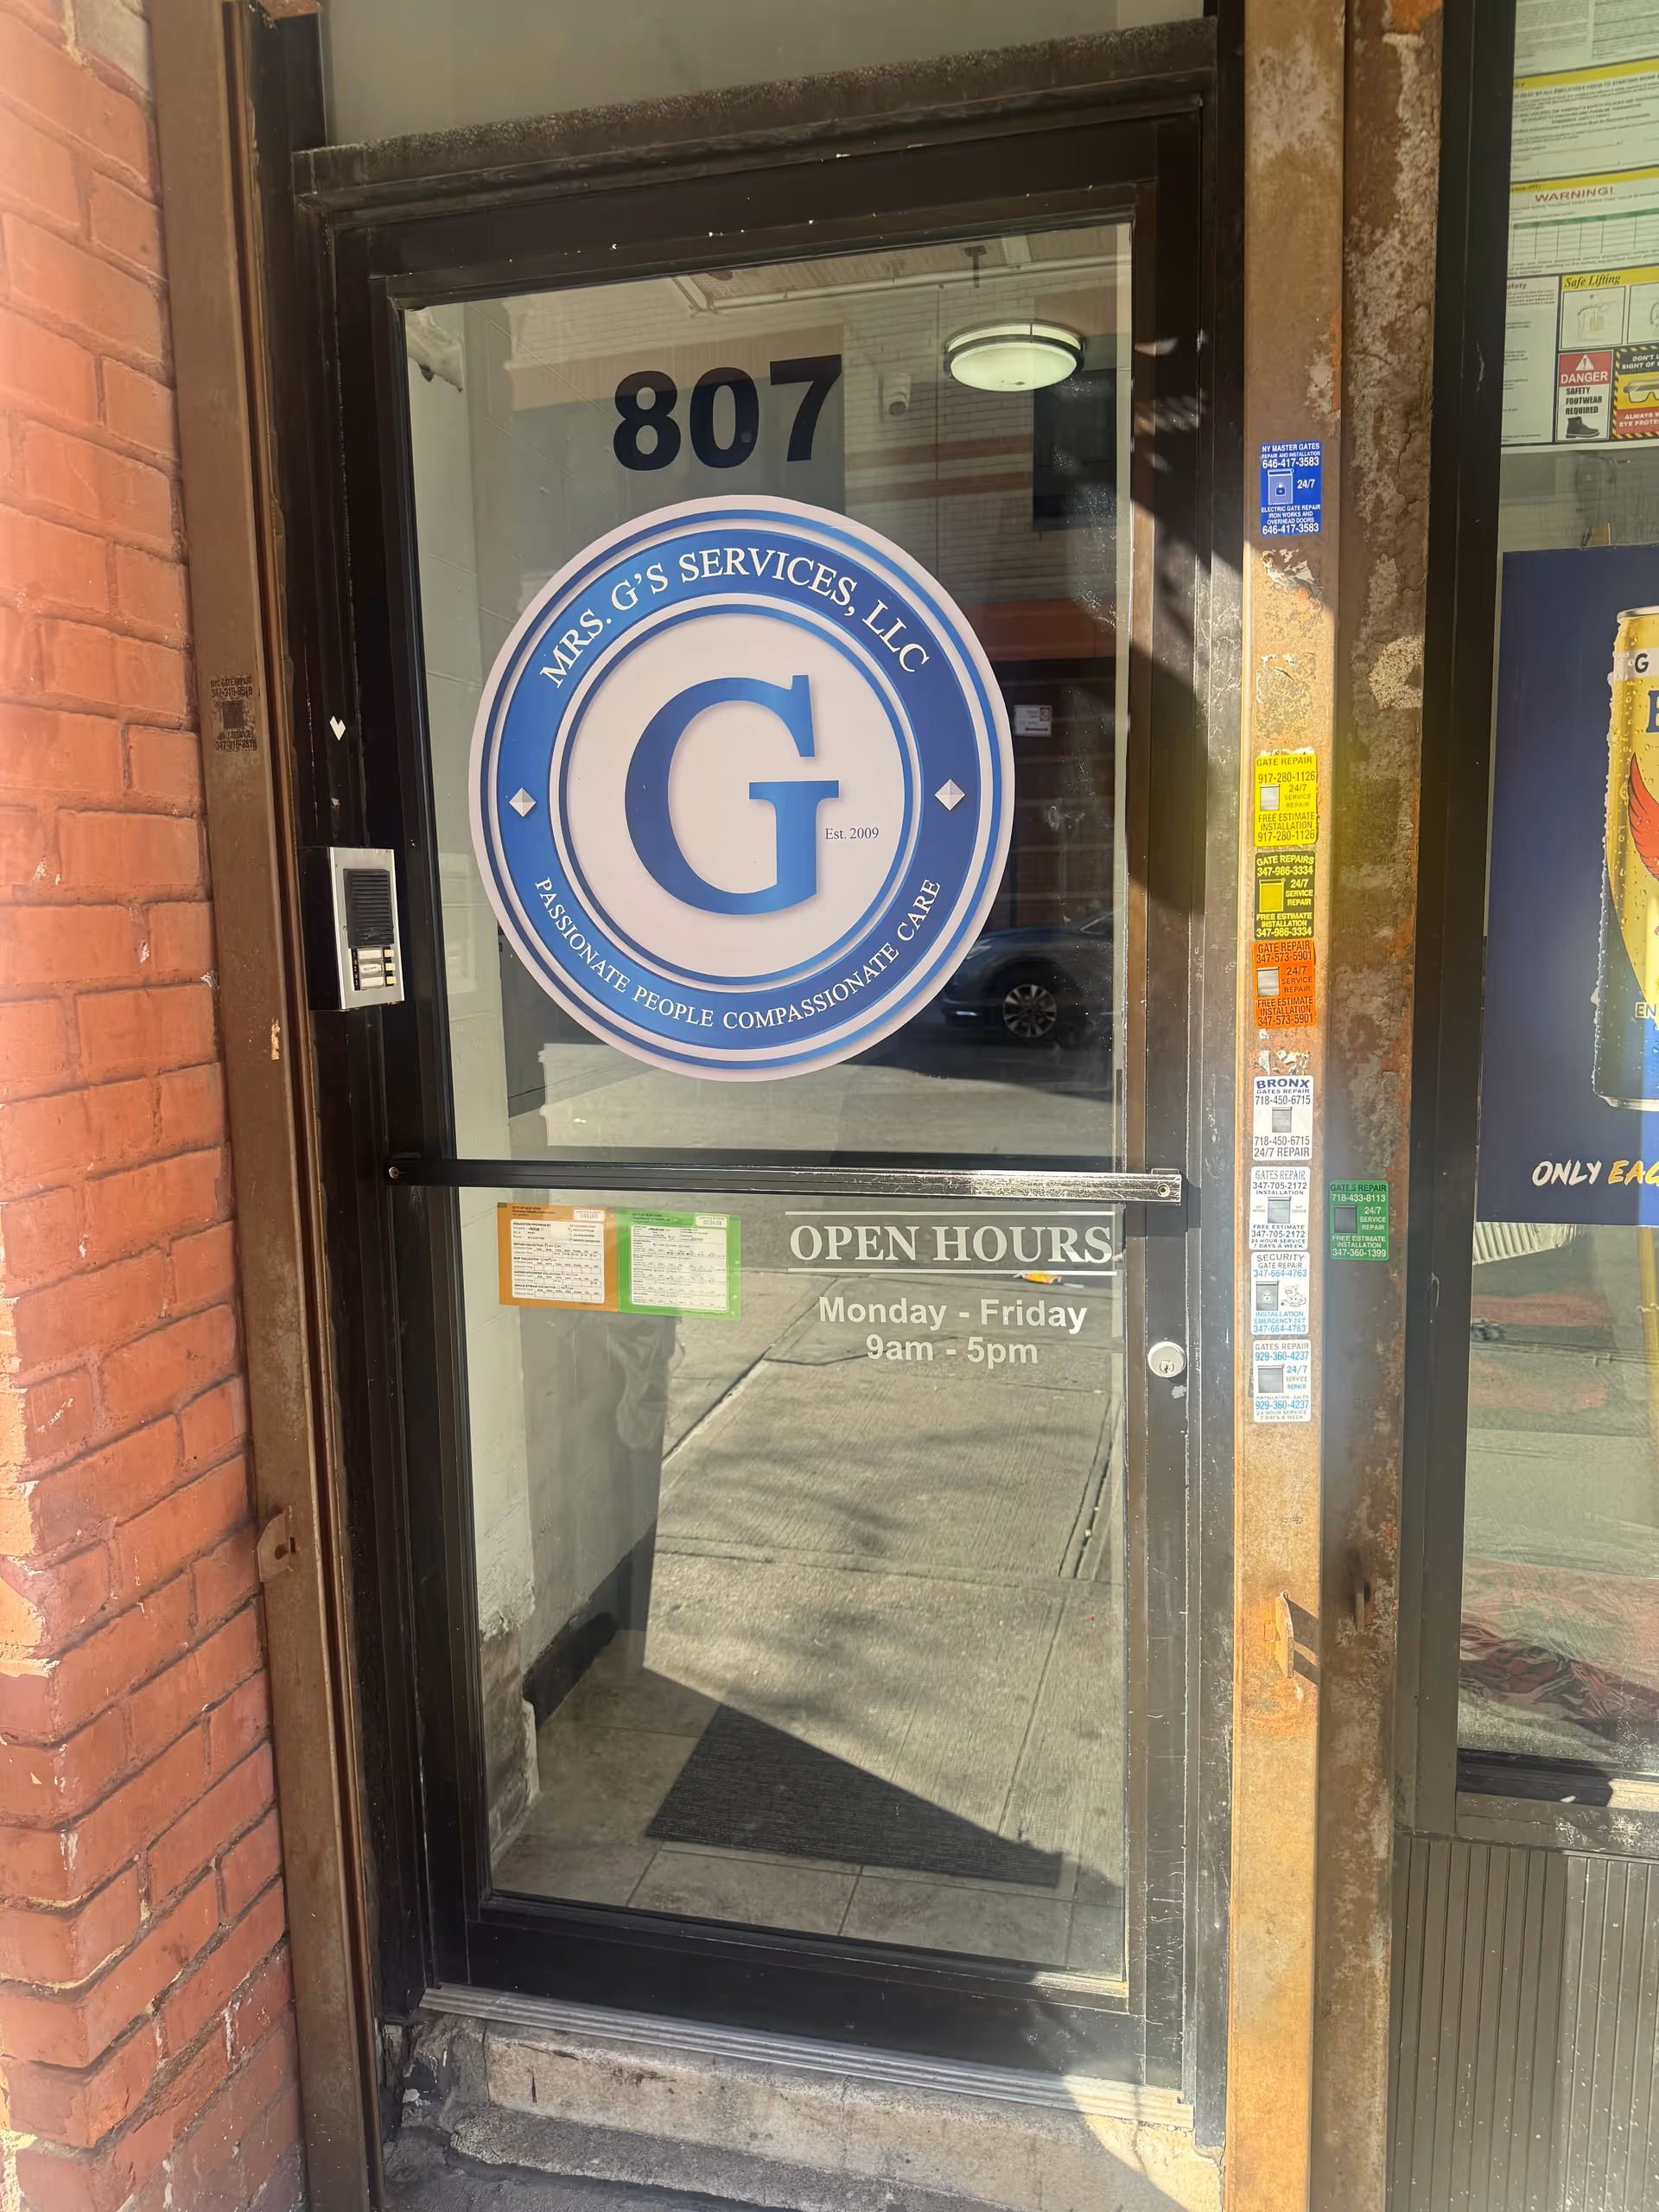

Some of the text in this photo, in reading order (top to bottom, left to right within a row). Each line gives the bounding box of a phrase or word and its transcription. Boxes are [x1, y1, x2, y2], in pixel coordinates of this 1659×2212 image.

[1535, 186, 1613, 202] WARNING!
[1565, 275, 1620, 289] Safe Lifting
[1561, 372, 1607, 384] DANGER
[1566, 396, 1602, 405] FOOTWEAR
[613, 354, 842, 471] 807
[1566, 406, 1598, 415] REQUIRED
[1262, 457, 1319, 469] 646-417-3583
[1297, 479, 1315, 489] 24/7
[1262, 523, 1319, 535] 646-417-3583
[539, 547, 931, 689] MRS. G'S SERVICES, LLC
[1635, 653, 1649, 673] G
[1257, 757, 1312, 766] GATE REPAIR
[1258, 771, 1315, 784] 917-280-1126
[625, 675, 840, 915] G
[1258, 812, 1314, 822] FREE ESTIMATE
[1261, 821, 1312, 831] INSTALLATION
[824, 826, 880, 841] Est. 2009
[1258, 830, 1315, 842] 917-280-1126
[1257, 855, 1314, 866] GATE REPAIRS
[1257, 866, 1313, 876] 347-986-3334
[1291, 879, 1309, 888] 24/7
[1256, 927, 1312, 937] 347-986-3334
[1258, 941, 1310, 953] GATE REPAIR
[535, 877, 941, 1030] PASSIONATE PEOPLE COMPASSIONATE CARE
[1257, 951, 1312, 964] 347-573-5901
[1287, 966, 1307, 975] 24/7
[1258, 996, 1313, 1008] FREE ESTIMATE
[1260, 1005, 1310, 1016] INSTALLATION
[1258, 1014, 1313, 1026] 347-573-5901
[1257, 1079, 1310, 1089] BRONX
[1256, 1095, 1310, 1105] 718-450-6715
[1255, 1136, 1310, 1146] 718-450-6715
[1254, 1147, 1309, 1157] 24/7 REPAIR
[1255, 1170, 1305, 1180] GATES REPAIR
[1532, 1159, 1602, 1187] ONLY
[1332, 1194, 1385, 1202] 718-433-8113
[790, 1225, 1113, 1264] OPEN HOURS
[1333, 1248, 1386, 1257] 347-360-1399
[819, 1296, 947, 1331] Monday
[980, 1299, 1087, 1335] Friday
[866, 1334, 934, 1361] 9am
[967, 1337, 1038, 1370] 5pm
[1255, 1351, 1309, 1361] 929-360-4237
[1287, 1366, 1307, 1374] 24/7
[1256, 1400, 1309, 1410] 929-360-4237
